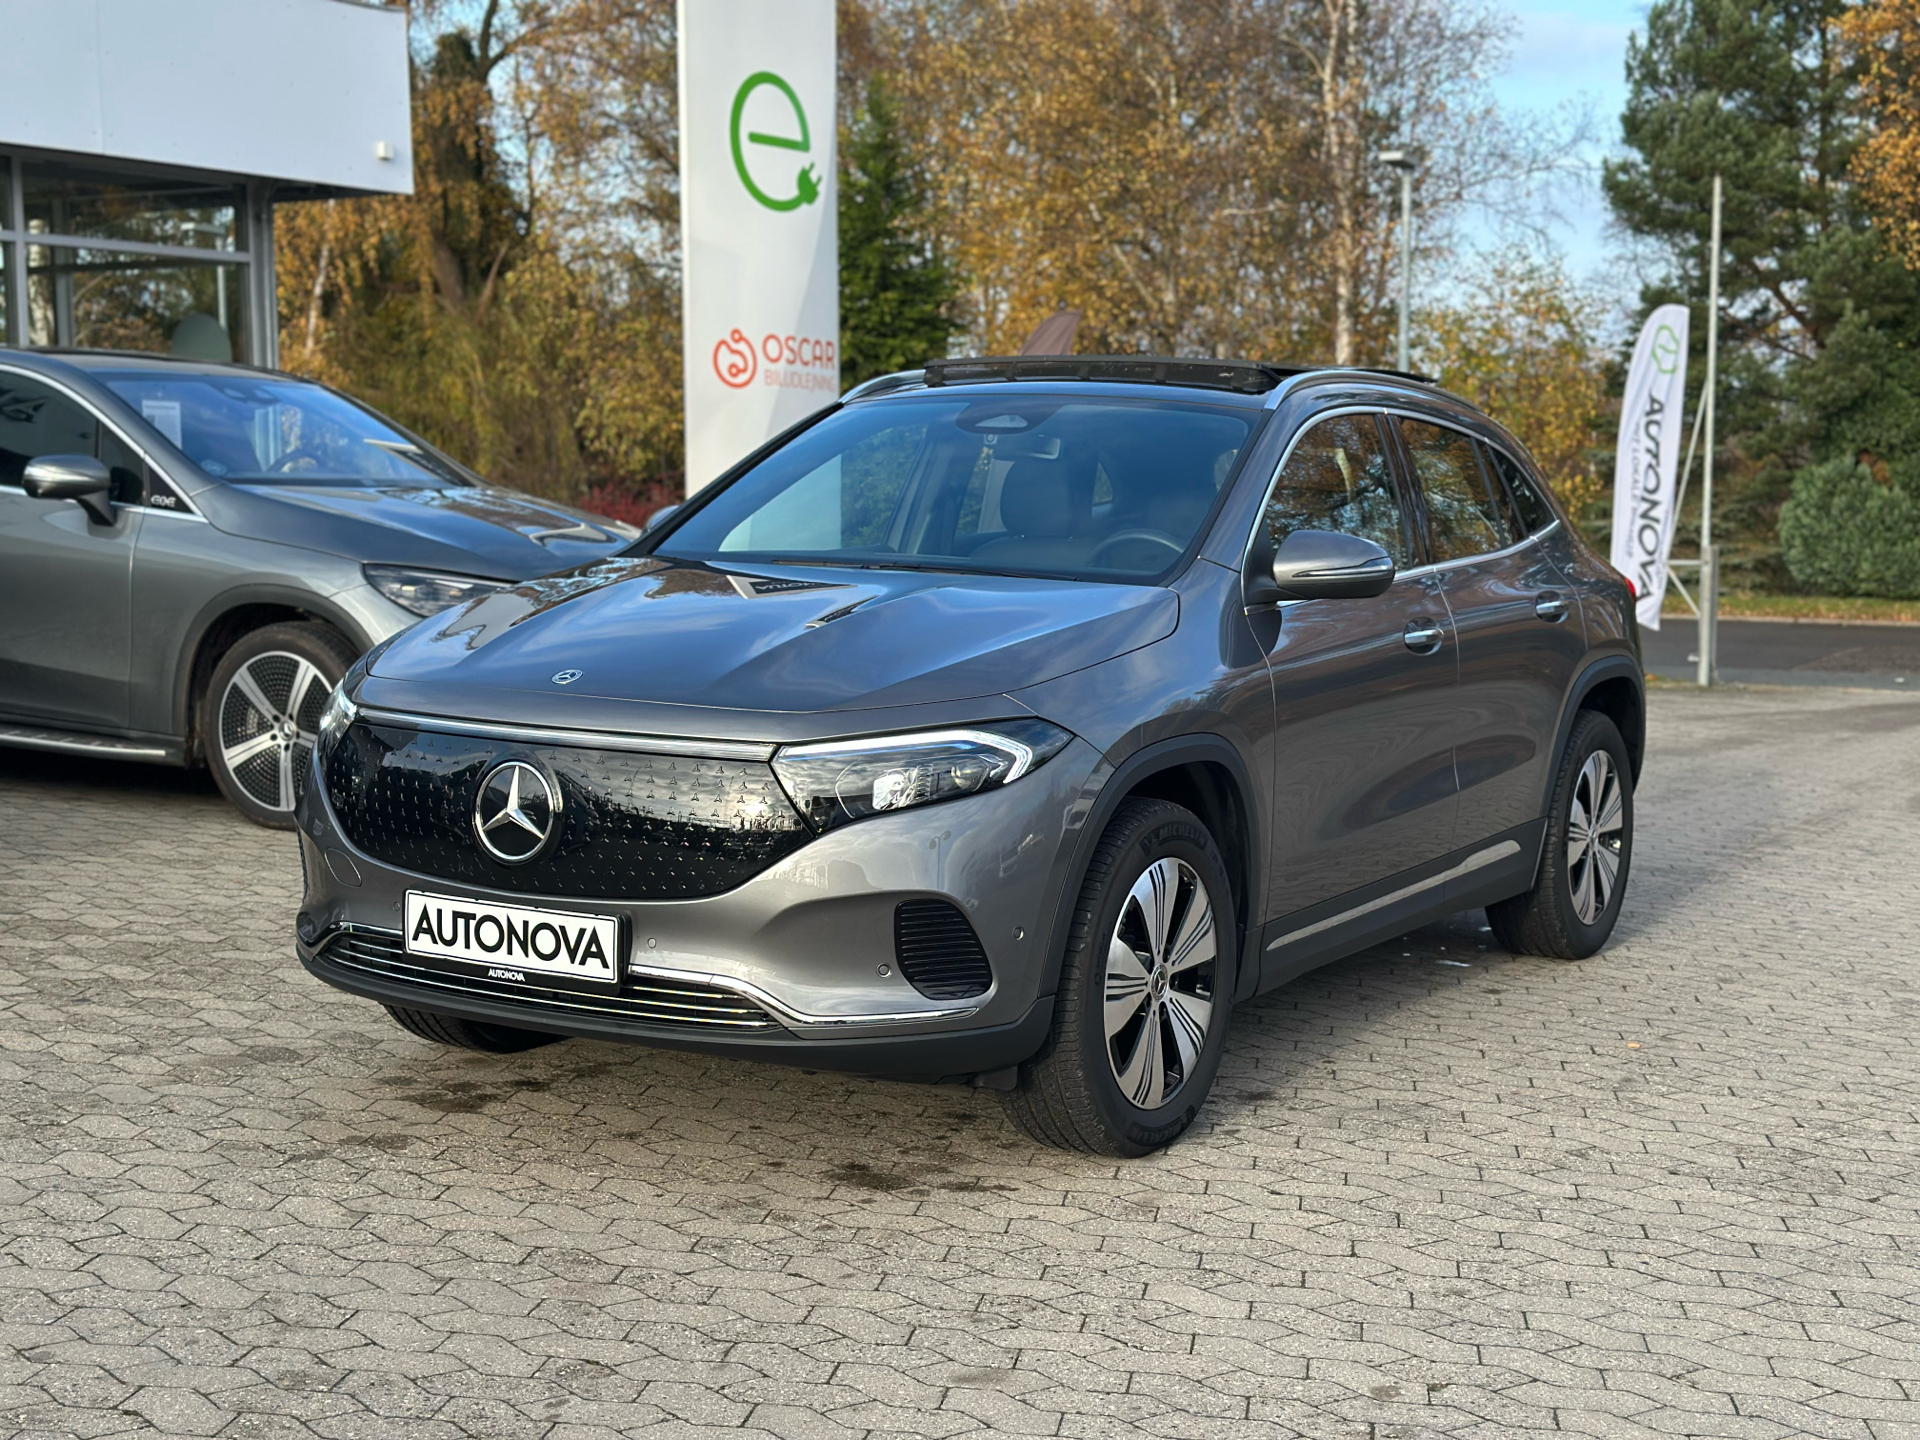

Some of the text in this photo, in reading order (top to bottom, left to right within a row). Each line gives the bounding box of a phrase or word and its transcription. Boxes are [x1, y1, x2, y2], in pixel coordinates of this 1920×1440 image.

[762, 334, 835, 370] OSCAR
[1635, 393, 1664, 602] AUTONOVA
[412, 903, 610, 969] AUTONOVA
[488, 968, 526, 982] AUTONOVA
